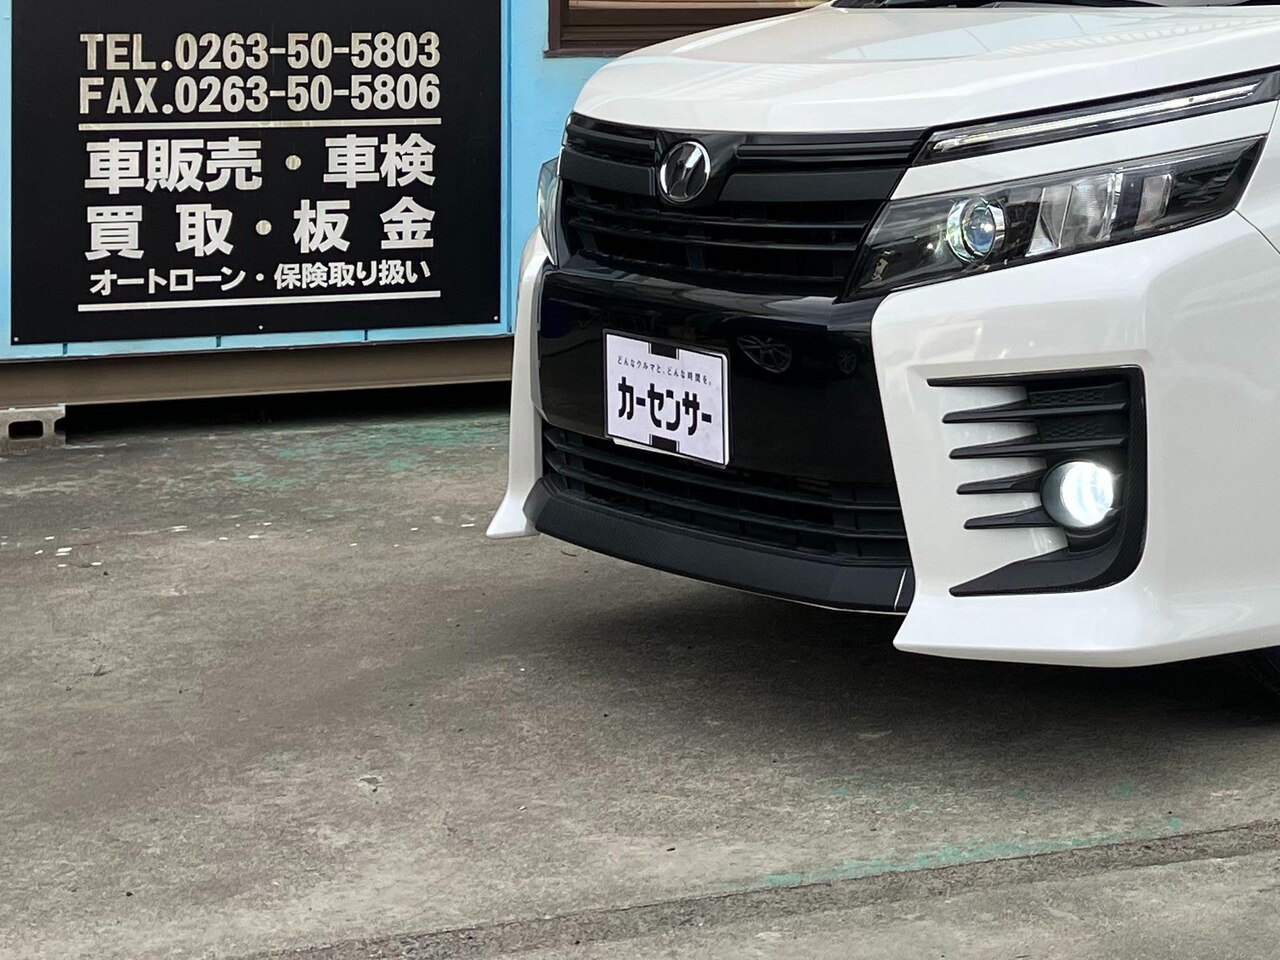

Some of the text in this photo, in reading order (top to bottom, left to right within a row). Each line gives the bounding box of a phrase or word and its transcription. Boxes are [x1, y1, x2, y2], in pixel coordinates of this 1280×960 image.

[79, 31, 441, 71] TEL.0263-50-5803
[79, 73, 441, 115] FAX.0263-50-5806
[84, 132, 436, 195] 車販売・車検
[89, 259, 431, 296] オートローン・保険取り扱い
[617, 376, 712, 436] カーセンサー
